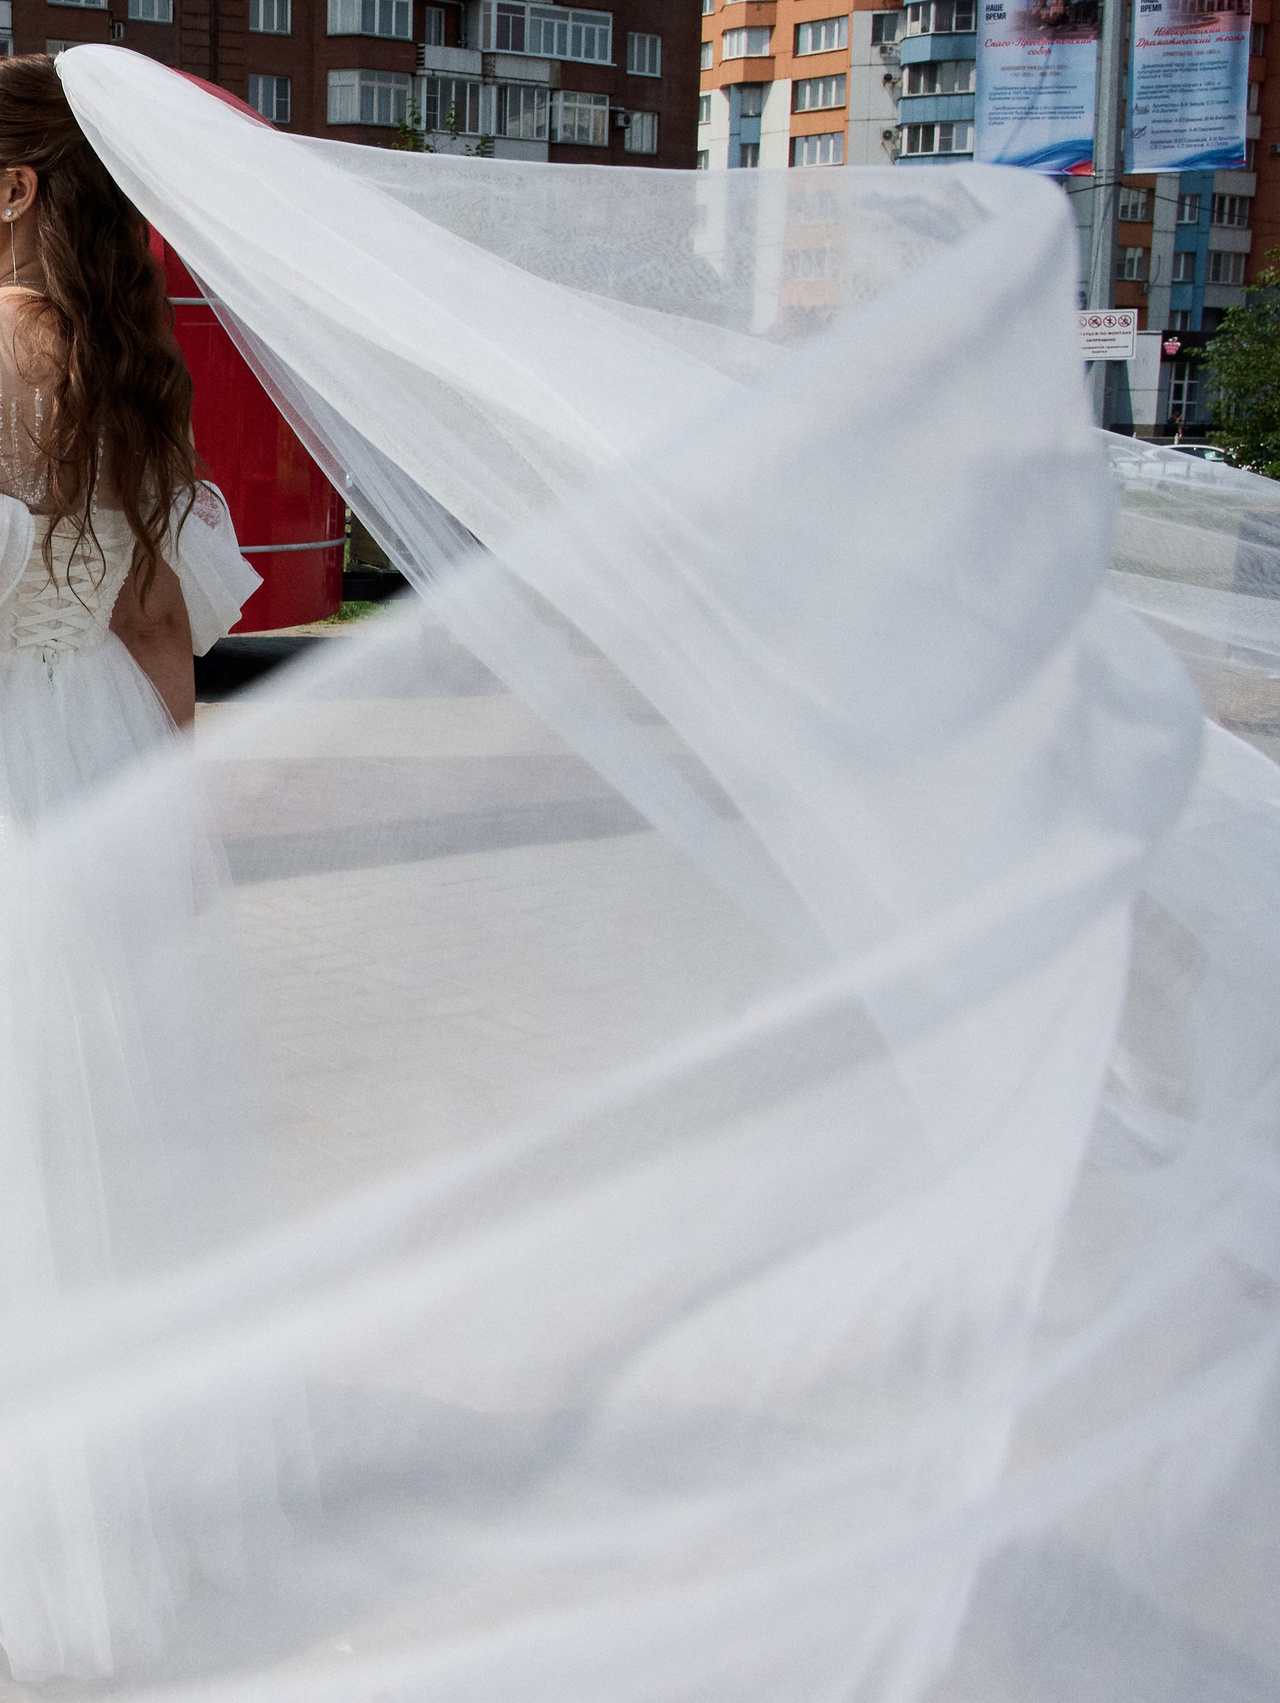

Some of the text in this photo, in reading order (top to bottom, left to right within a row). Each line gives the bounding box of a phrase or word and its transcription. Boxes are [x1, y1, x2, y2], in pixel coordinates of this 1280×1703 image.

[985, 4, 1003, 12] НАШЕ
[1140, 3, 1162, 13] ВРЕМЯ
[985, 12, 1007, 21] ВРЕМЯ
[1135, 33, 1246, 49] Драматический театр
[1027, 46, 1052, 57] собор
